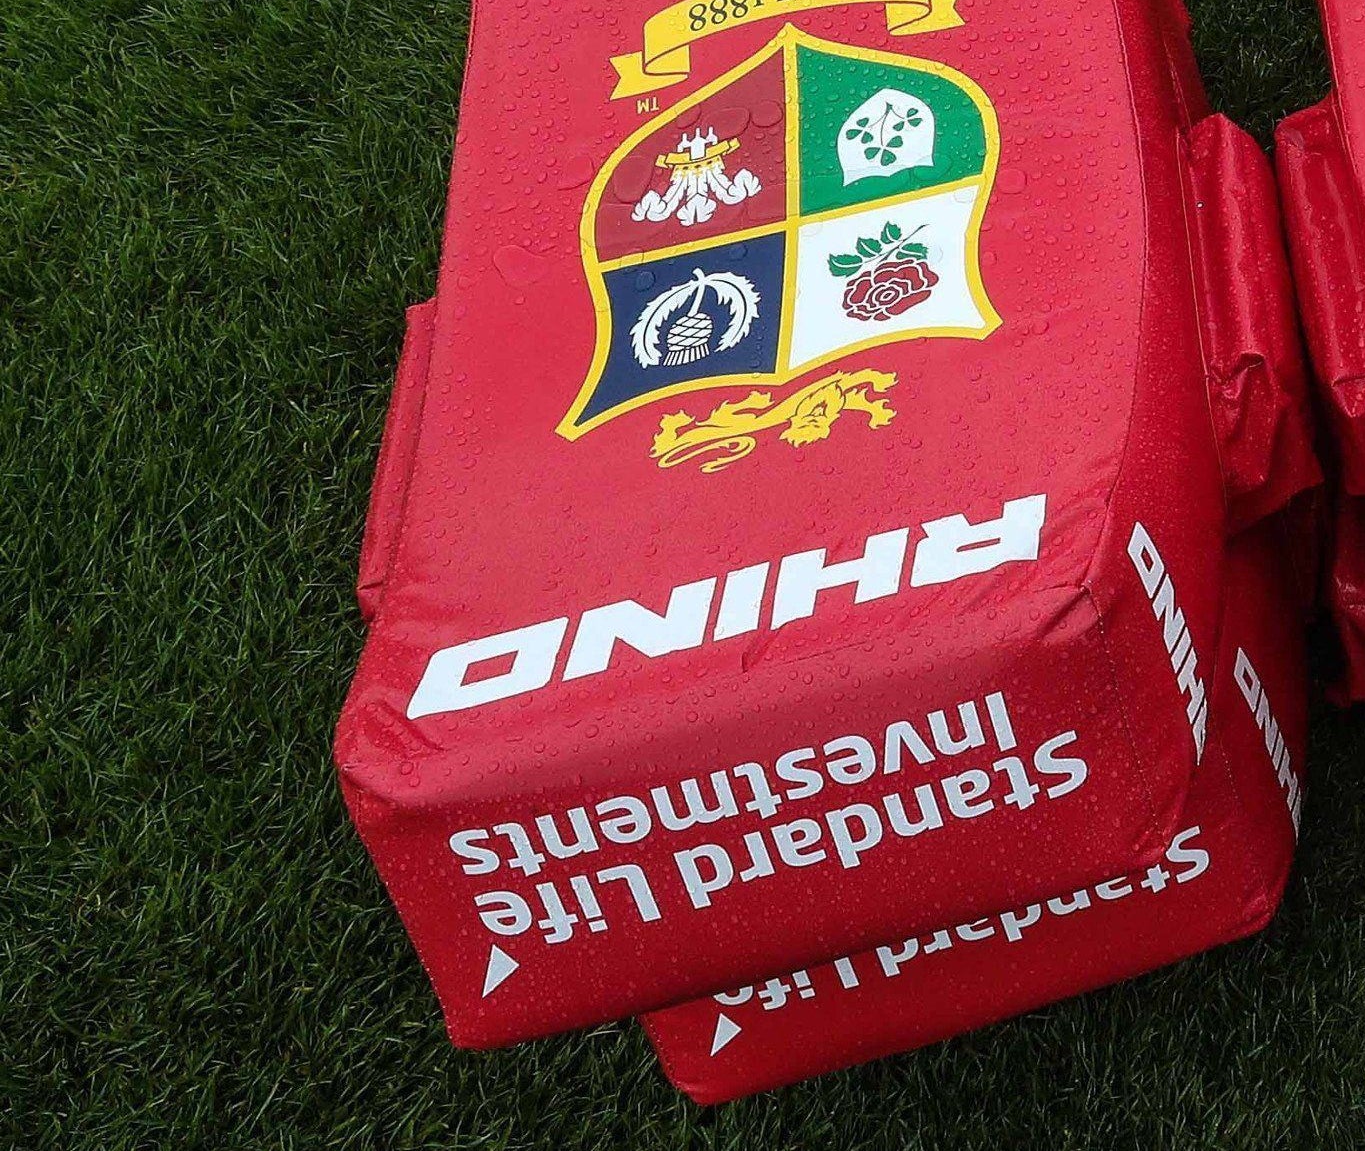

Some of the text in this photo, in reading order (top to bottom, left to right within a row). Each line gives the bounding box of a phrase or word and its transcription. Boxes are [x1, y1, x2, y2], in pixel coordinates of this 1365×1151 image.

[636, 96, 660, 114] TM
[406, 493, 1047, 720] RHINO
[1127, 521, 1208, 766] RHINO
[449, 692, 1014, 876] Investments
[475, 729, 1089, 944] Standard Life
